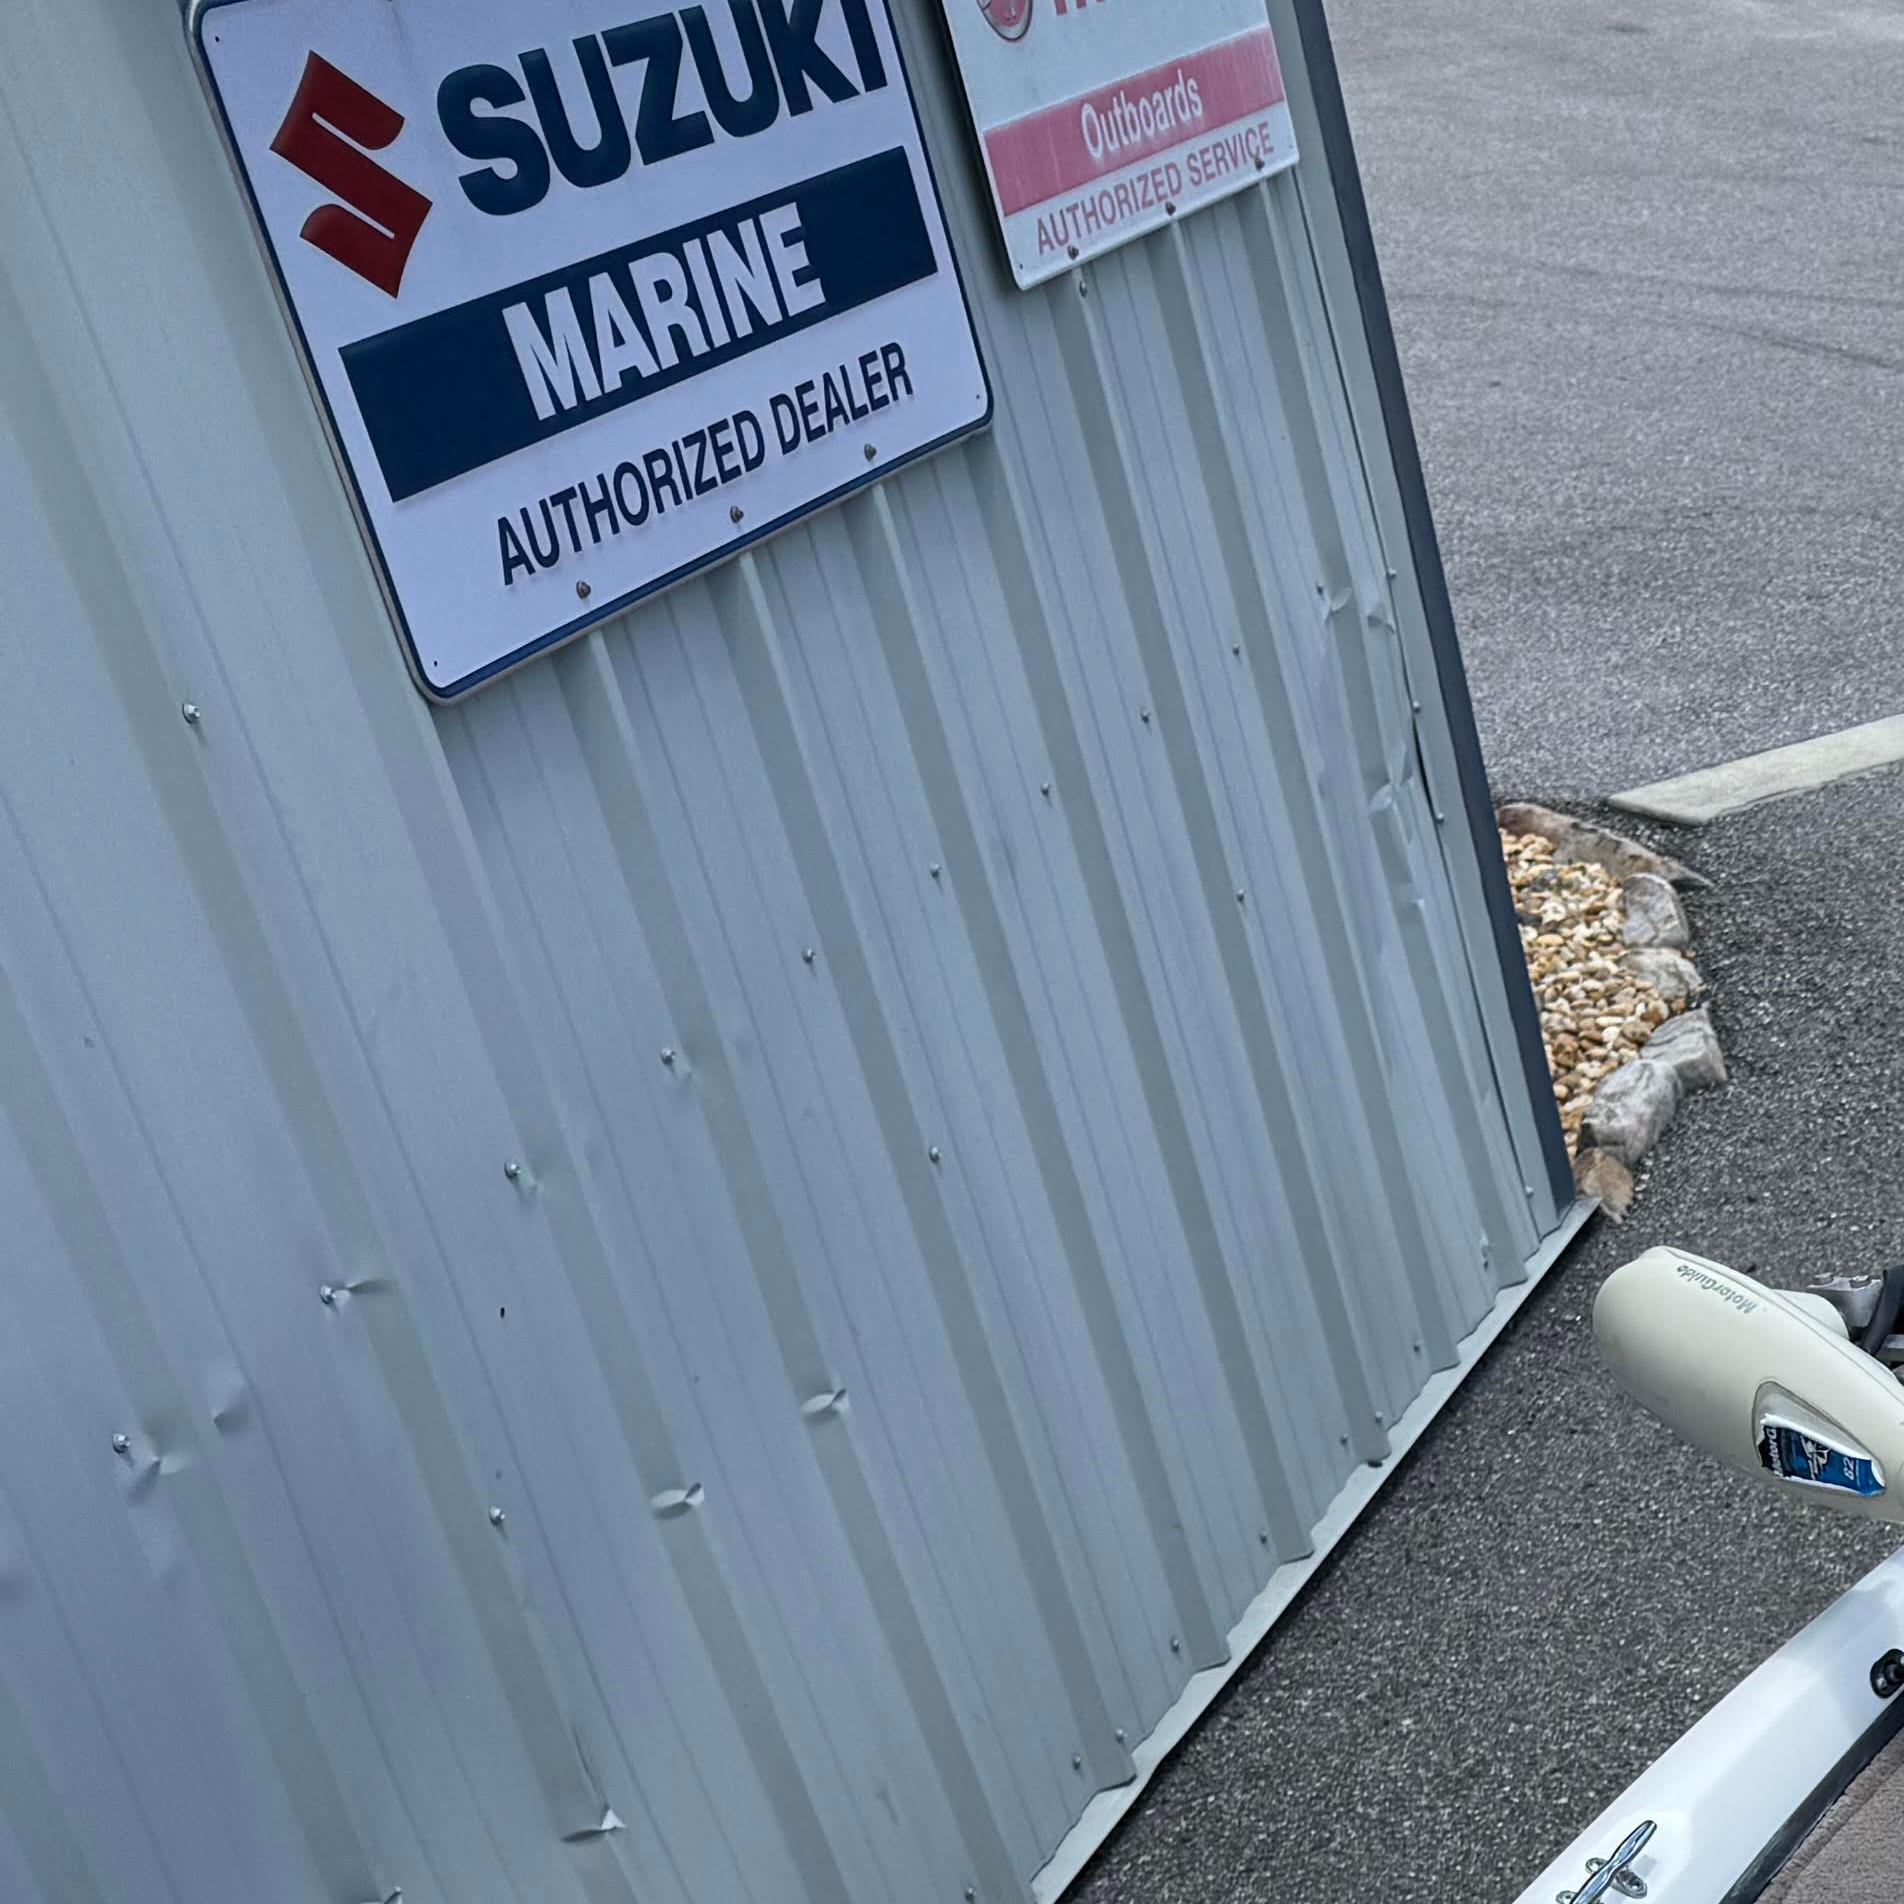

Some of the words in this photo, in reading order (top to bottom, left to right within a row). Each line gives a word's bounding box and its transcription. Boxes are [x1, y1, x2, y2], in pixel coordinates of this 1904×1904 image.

[437, 0, 888, 216] SUZUKI
[1037, 162, 1183, 256] AUTHORIZED
[1186, 122, 1275, 187] SERVICE
[1081, 69, 1204, 158] Outboards
[501, 202, 826, 422] MARINE
[497, 410, 765, 586] AUTHORIZED
[770, 342, 914, 455] DEALER
[1676, 1265, 1757, 1314] MotorGuide
